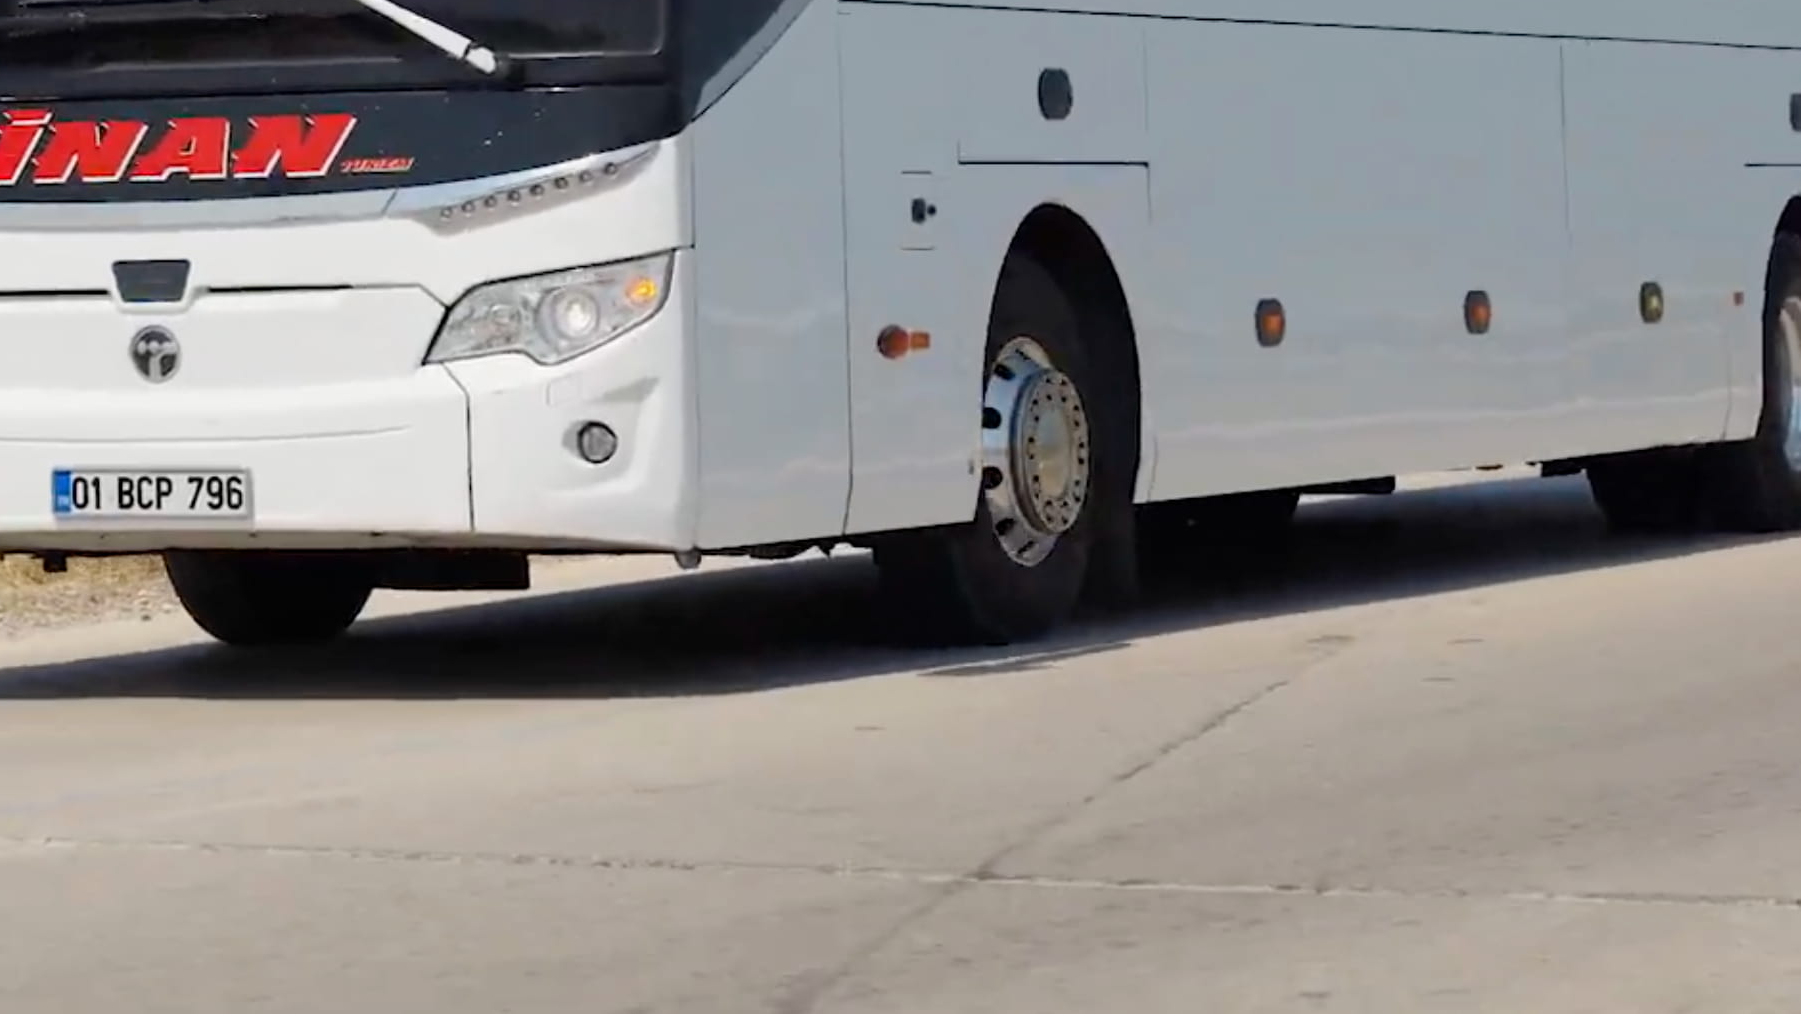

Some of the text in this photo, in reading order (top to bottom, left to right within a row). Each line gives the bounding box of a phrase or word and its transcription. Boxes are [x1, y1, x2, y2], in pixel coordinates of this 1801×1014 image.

[72, 476, 243, 511] 01 BCP 796
